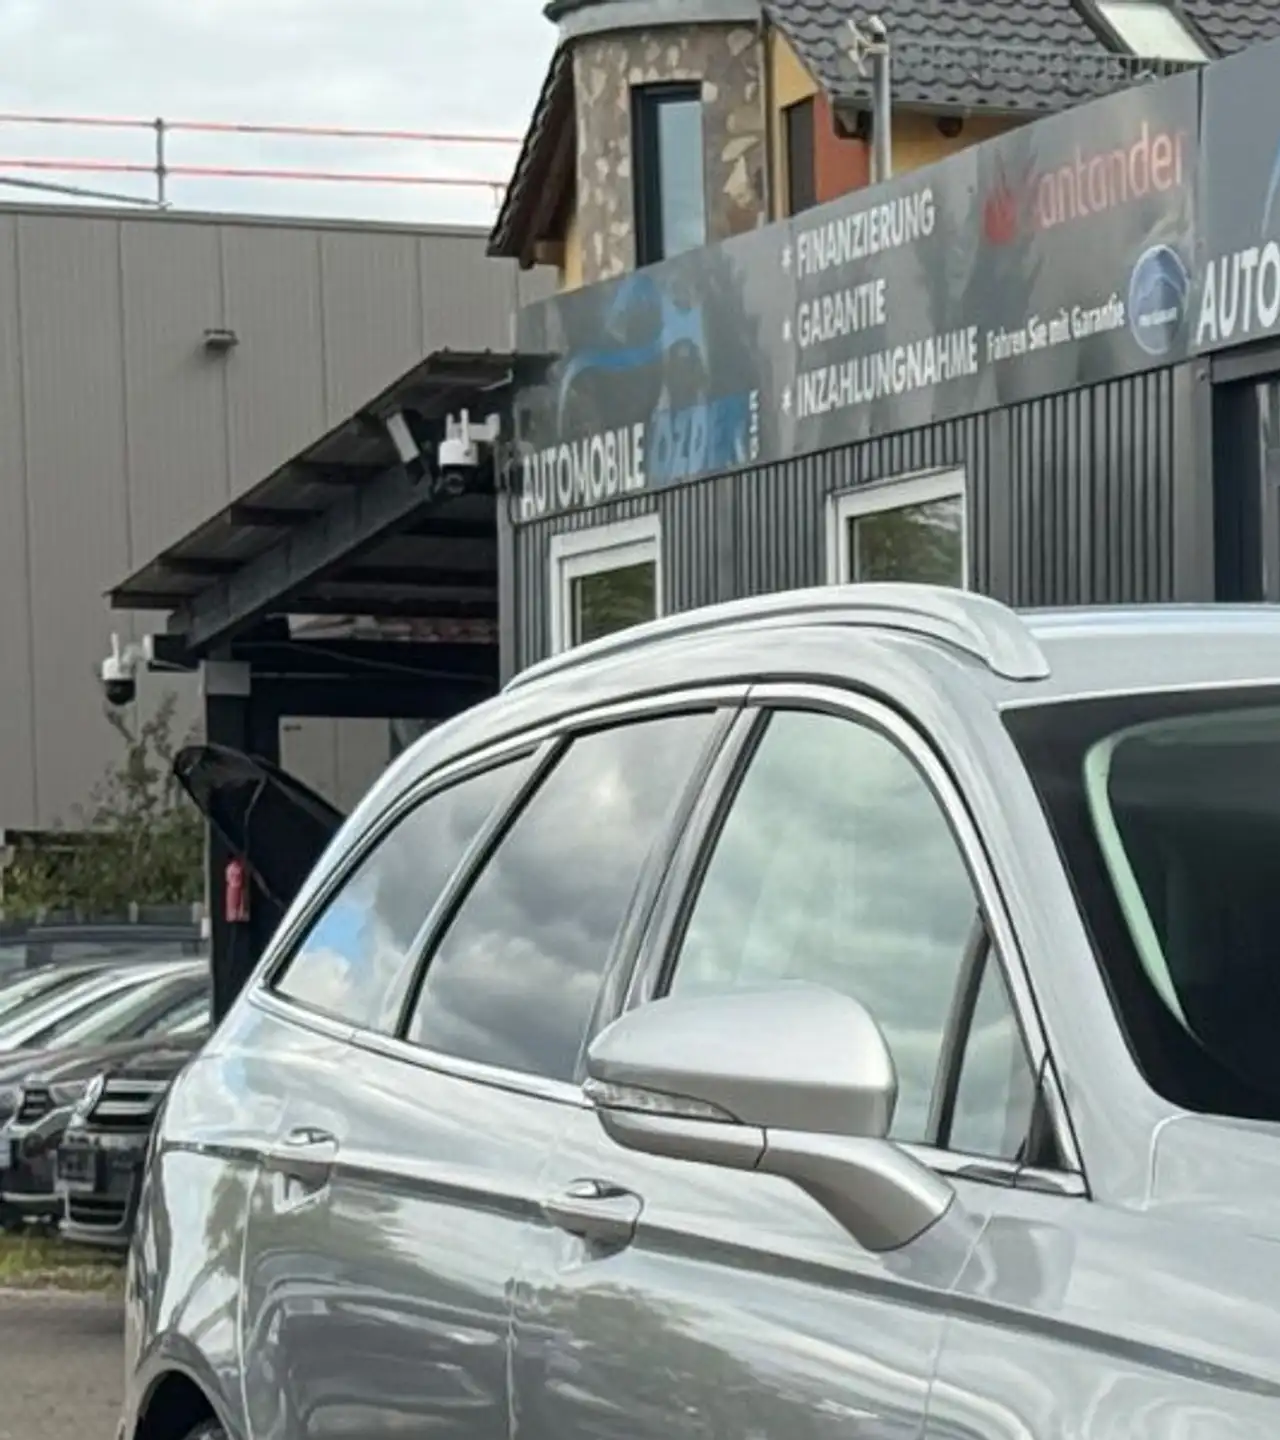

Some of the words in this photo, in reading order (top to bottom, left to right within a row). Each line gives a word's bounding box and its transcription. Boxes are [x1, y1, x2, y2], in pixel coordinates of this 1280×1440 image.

[795, 187, 936, 281] FINANZIERUNG
[797, 278, 887, 348] GARANTIE
[796, 325, 978, 419] INZAHLUNGNAHME
[520, 422, 646, 521] AUTOMOBILE
